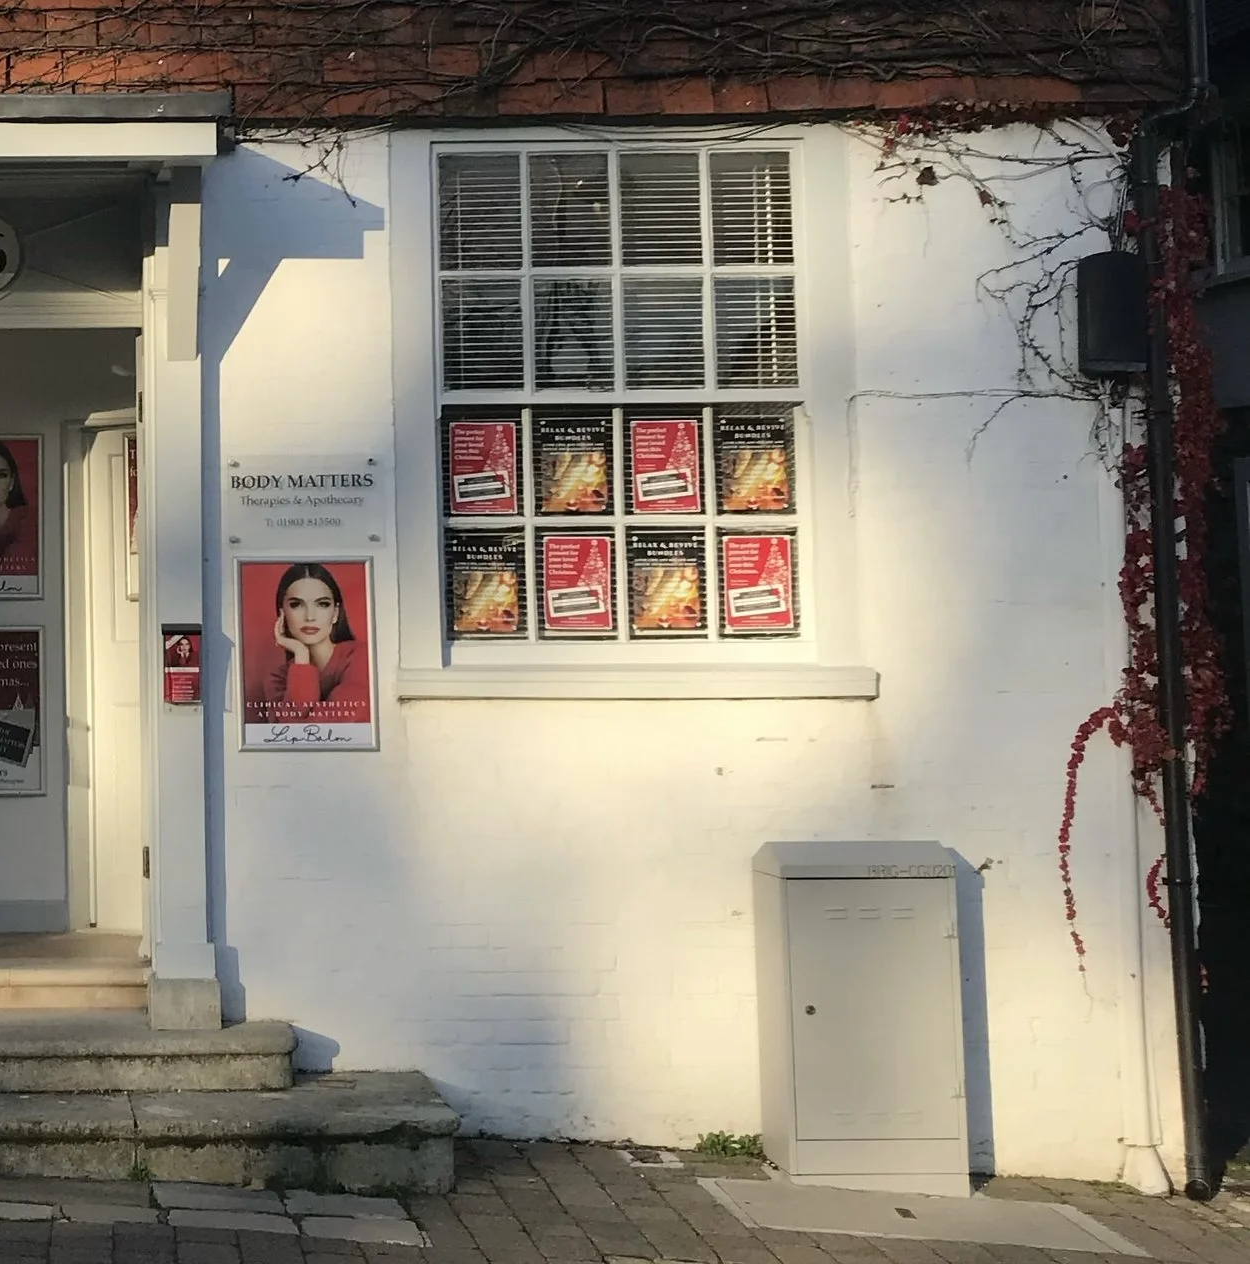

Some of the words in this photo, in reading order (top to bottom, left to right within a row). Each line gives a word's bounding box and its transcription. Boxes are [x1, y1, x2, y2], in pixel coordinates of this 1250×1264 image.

[231, 475, 282, 489] BODY
[287, 474, 374, 488] MATTERS
[240, 495, 290, 508] Therapies
[292, 497, 301, 506] &
[305, 494, 364, 508] Apothecary
[276, 518, 304, 527] 01903
[12, 659, 37, 670] ones
[263, 725, 300, 745] Lip
[302, 724, 352, 743] Balm
